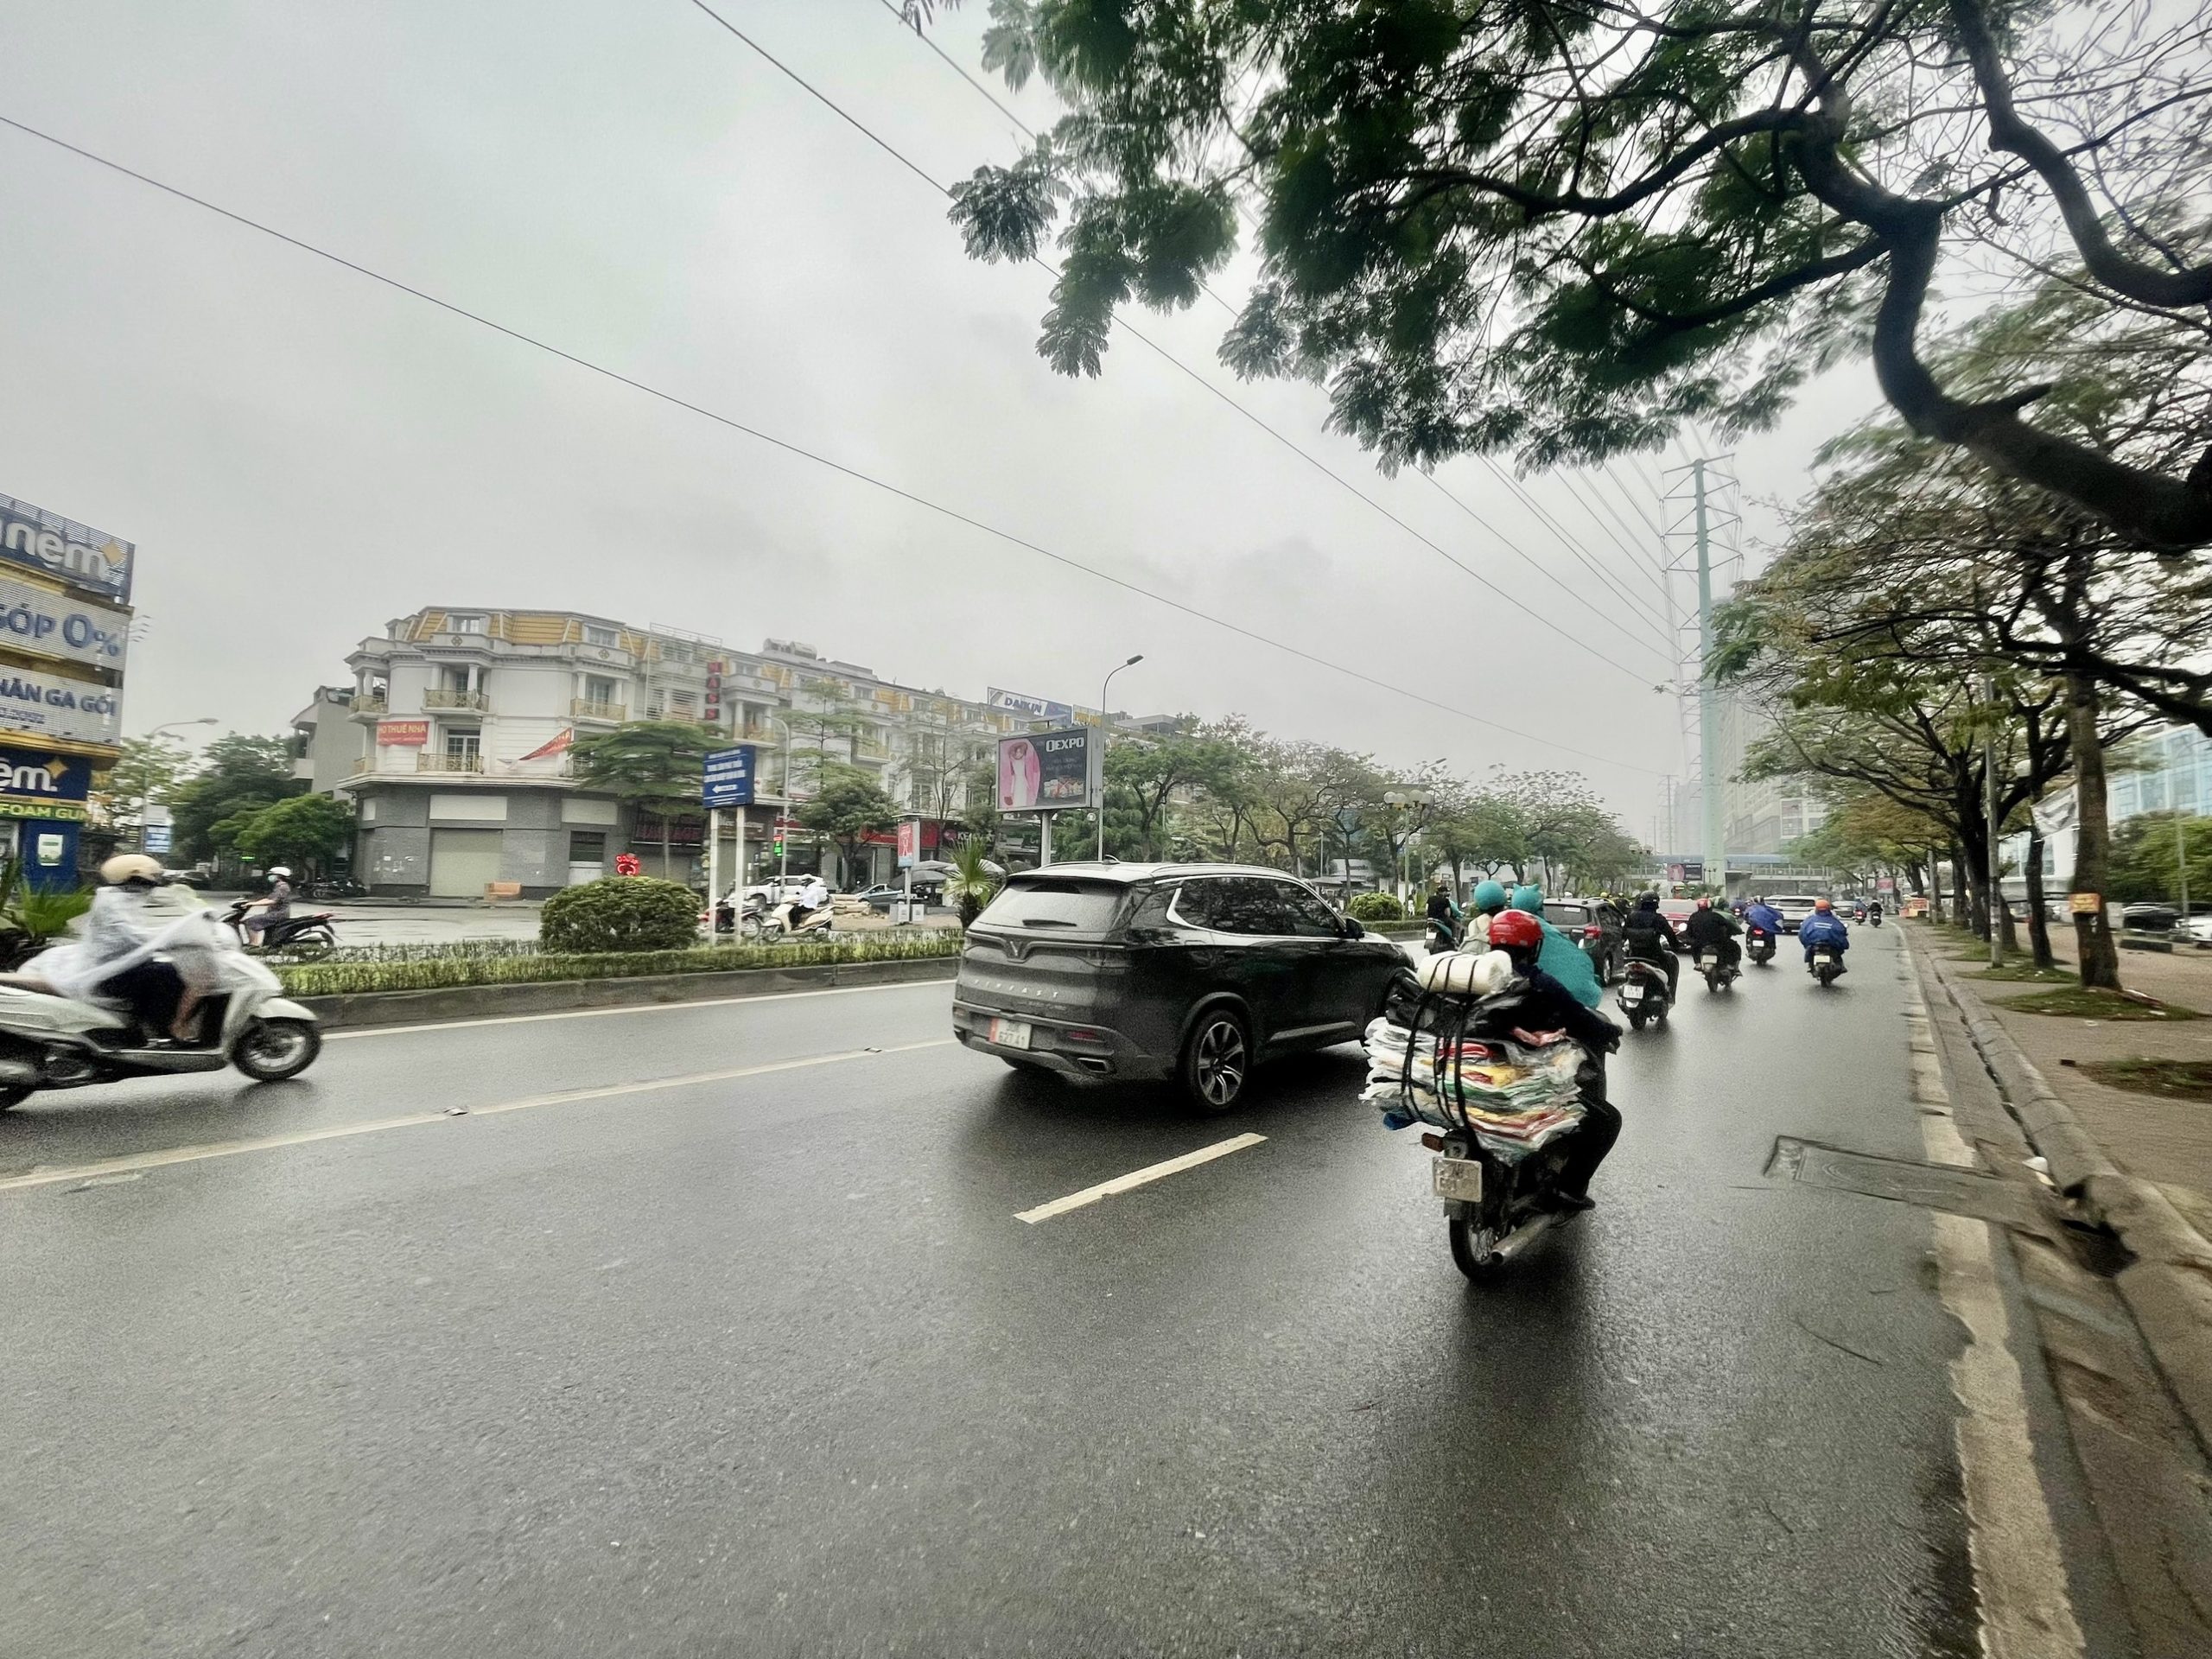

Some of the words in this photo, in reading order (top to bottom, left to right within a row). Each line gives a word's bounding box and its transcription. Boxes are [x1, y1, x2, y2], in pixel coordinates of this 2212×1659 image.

[63, 613, 120, 657] 0%
[46, 689, 76, 709] GA
[1004, 696, 1043, 714] DAIKIN
[0, 804, 52, 817] FOAM
